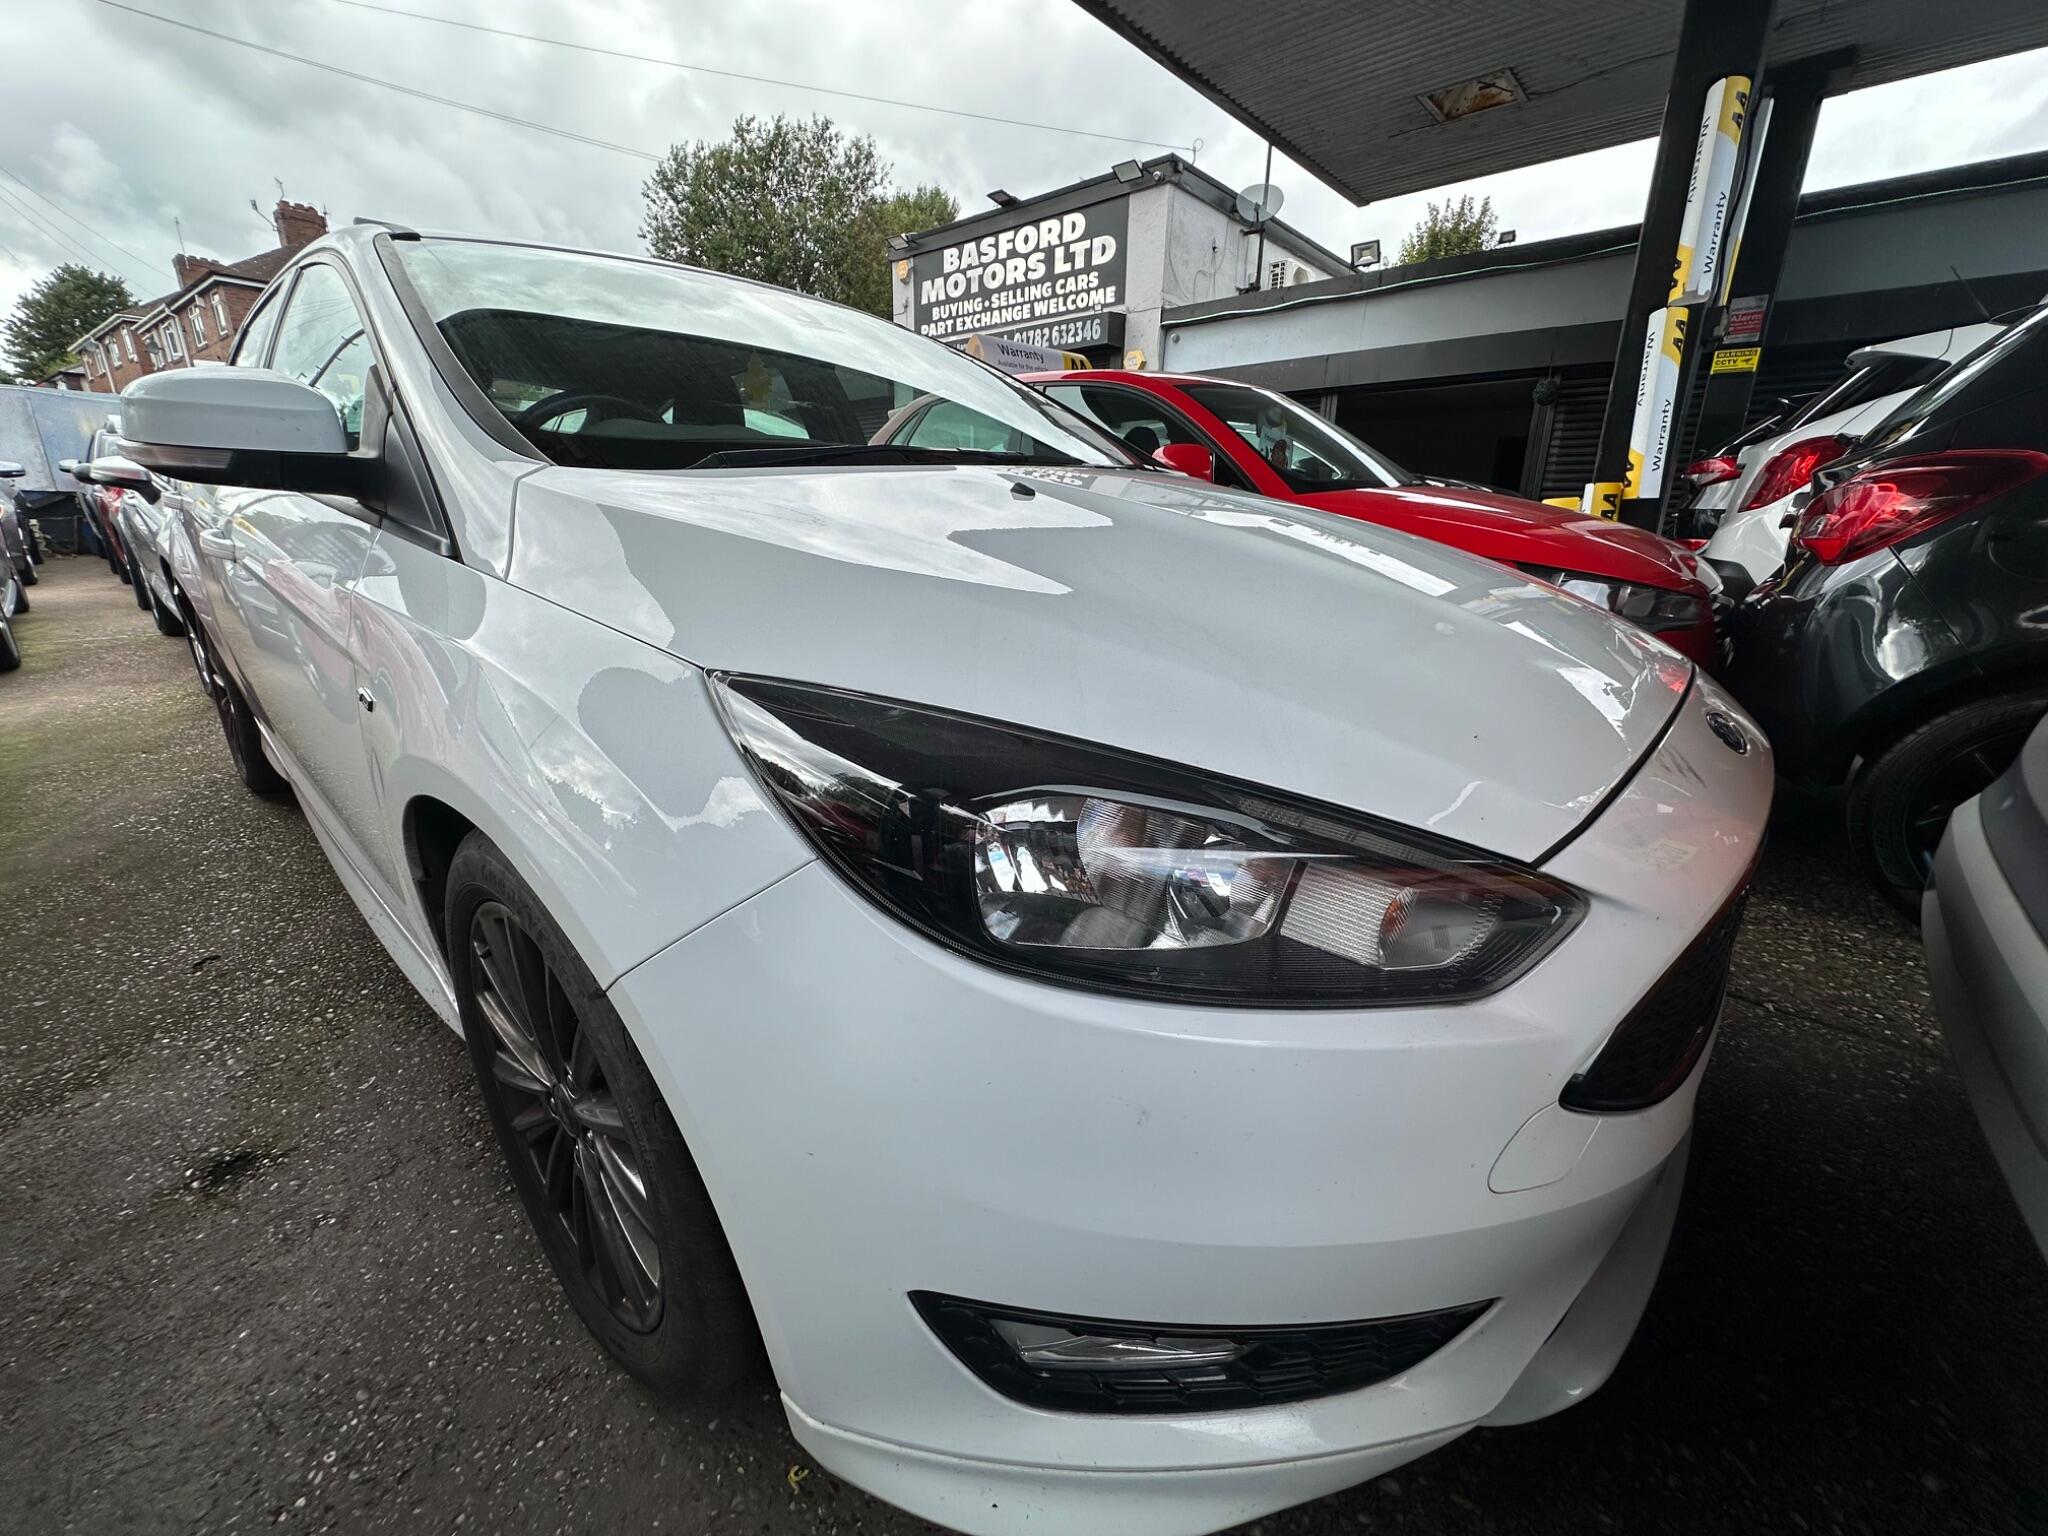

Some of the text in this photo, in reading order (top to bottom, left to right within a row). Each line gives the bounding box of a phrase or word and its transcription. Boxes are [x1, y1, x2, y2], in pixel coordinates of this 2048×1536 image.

[1687, 116, 1711, 203] Warranty
[943, 212, 1086, 273] BASFORD
[1703, 190, 1727, 275] Warranty
[920, 235, 1117, 305] MOTORS LTD
[921, 286, 1116, 337] PART EXCHANGE WELCOME
[932, 272, 1099, 321] BUYING SELLING CARS
[997, 343, 1045, 364] Warranty
[1052, 320, 1101, 345] 632346
[1672, 318, 1688, 358] AA
[1718, 350, 1756, 358] WARNING
[1071, 358, 1087, 370] AA
[1637, 331, 1656, 407] Warranty
[1715, 358, 1738, 366] CCTV
[1651, 397, 1673, 473] Warranty
